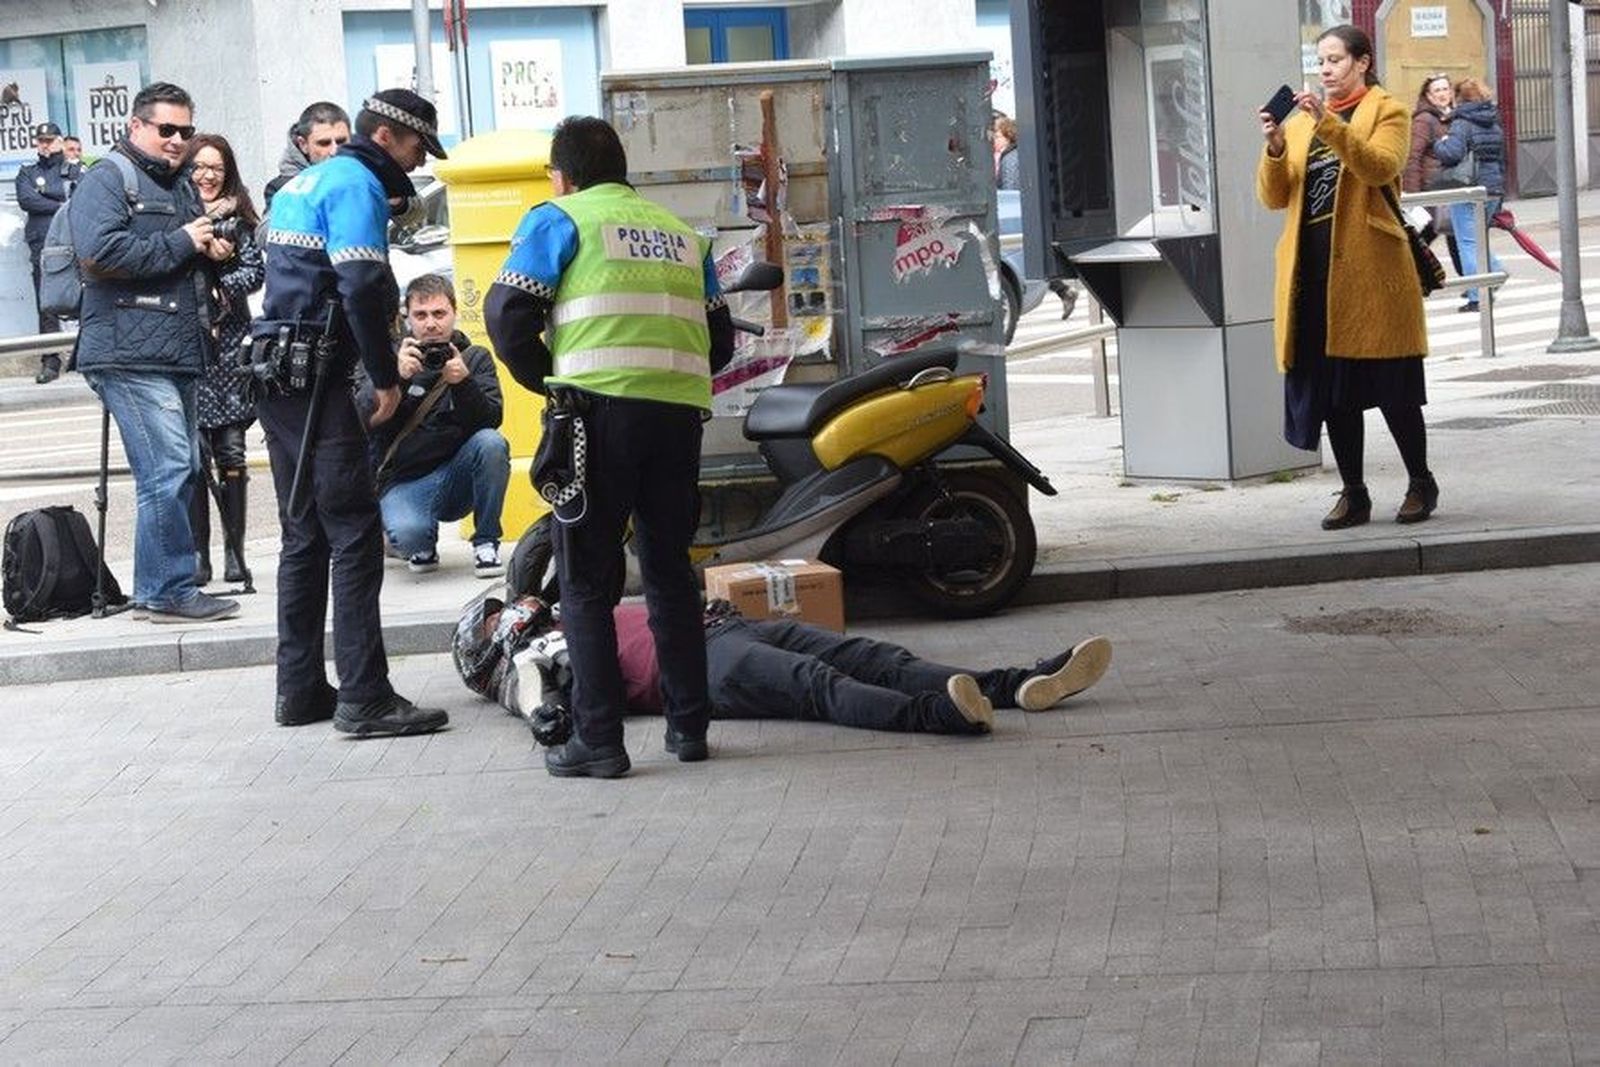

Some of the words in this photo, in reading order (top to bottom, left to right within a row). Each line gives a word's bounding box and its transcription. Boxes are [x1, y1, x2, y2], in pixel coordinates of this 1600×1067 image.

[0, 102, 32, 127] PRO
[90, 92, 128, 118] PRO
[618, 227, 686, 249] POLICIA
[629, 243, 683, 262] LOCAL
